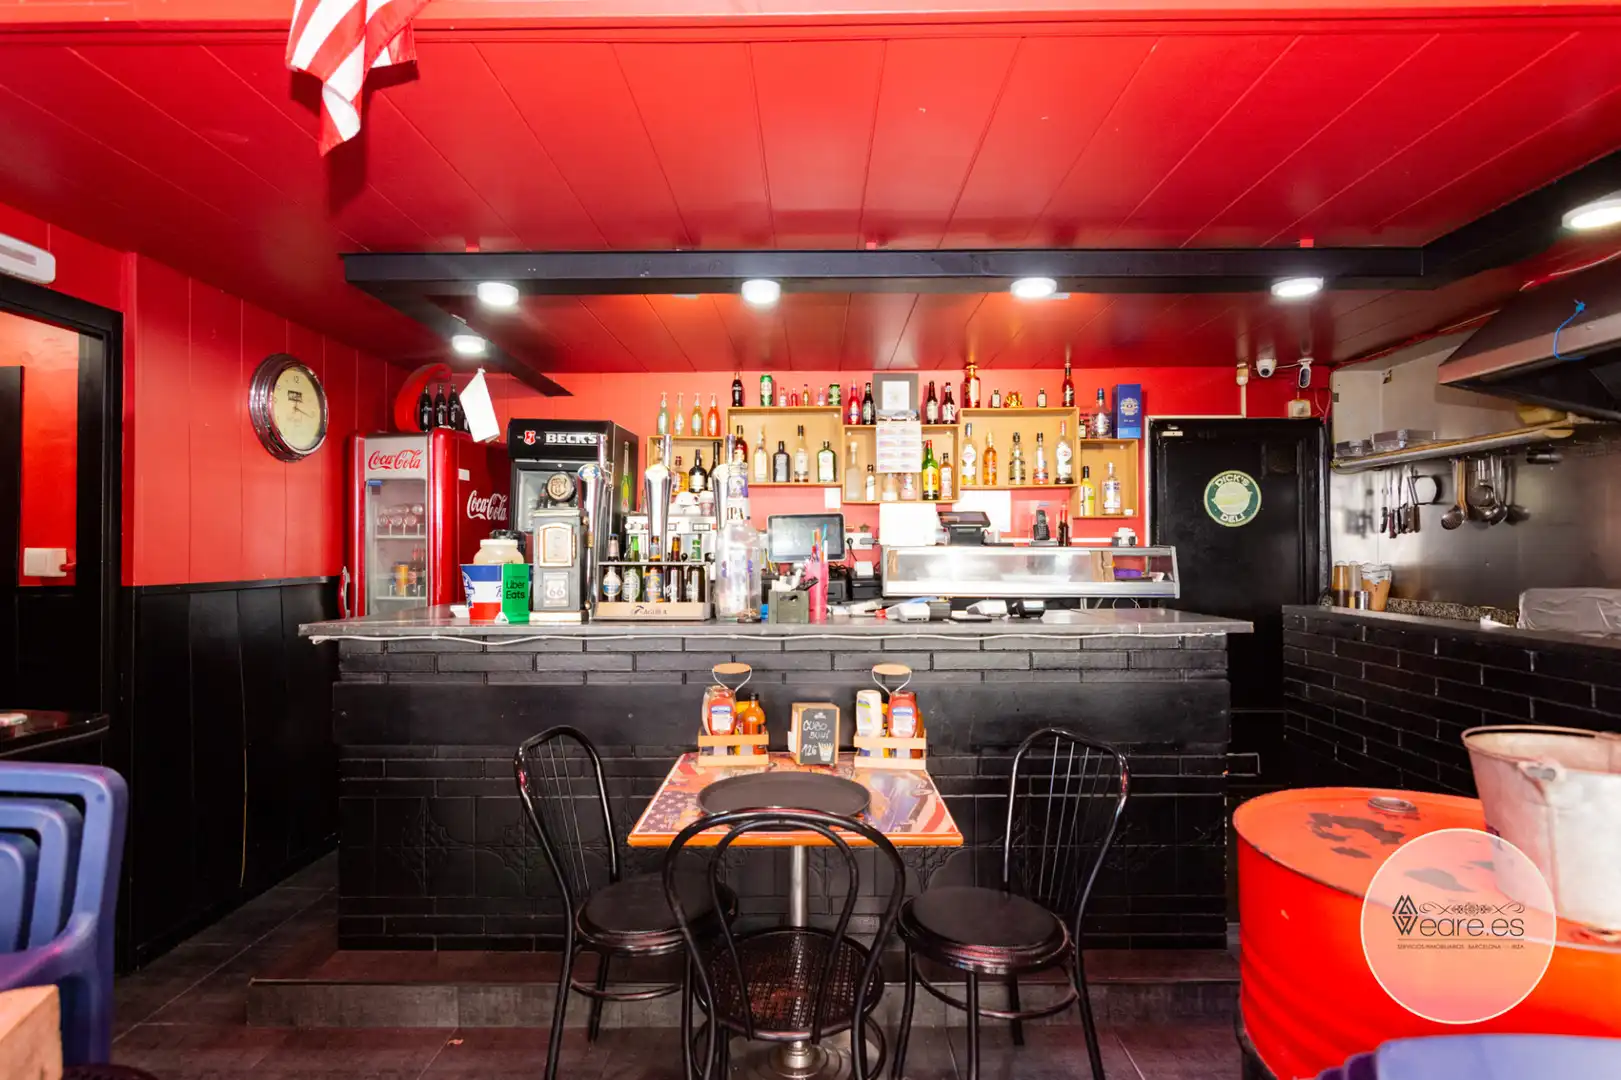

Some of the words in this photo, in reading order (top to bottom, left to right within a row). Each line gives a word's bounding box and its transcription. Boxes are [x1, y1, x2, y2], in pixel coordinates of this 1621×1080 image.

[545, 432, 598, 444] BECK'S
[1214, 474, 1250, 487] DICK'S
[505, 581, 526, 590] Uber
[505, 590, 526, 600] Eats
